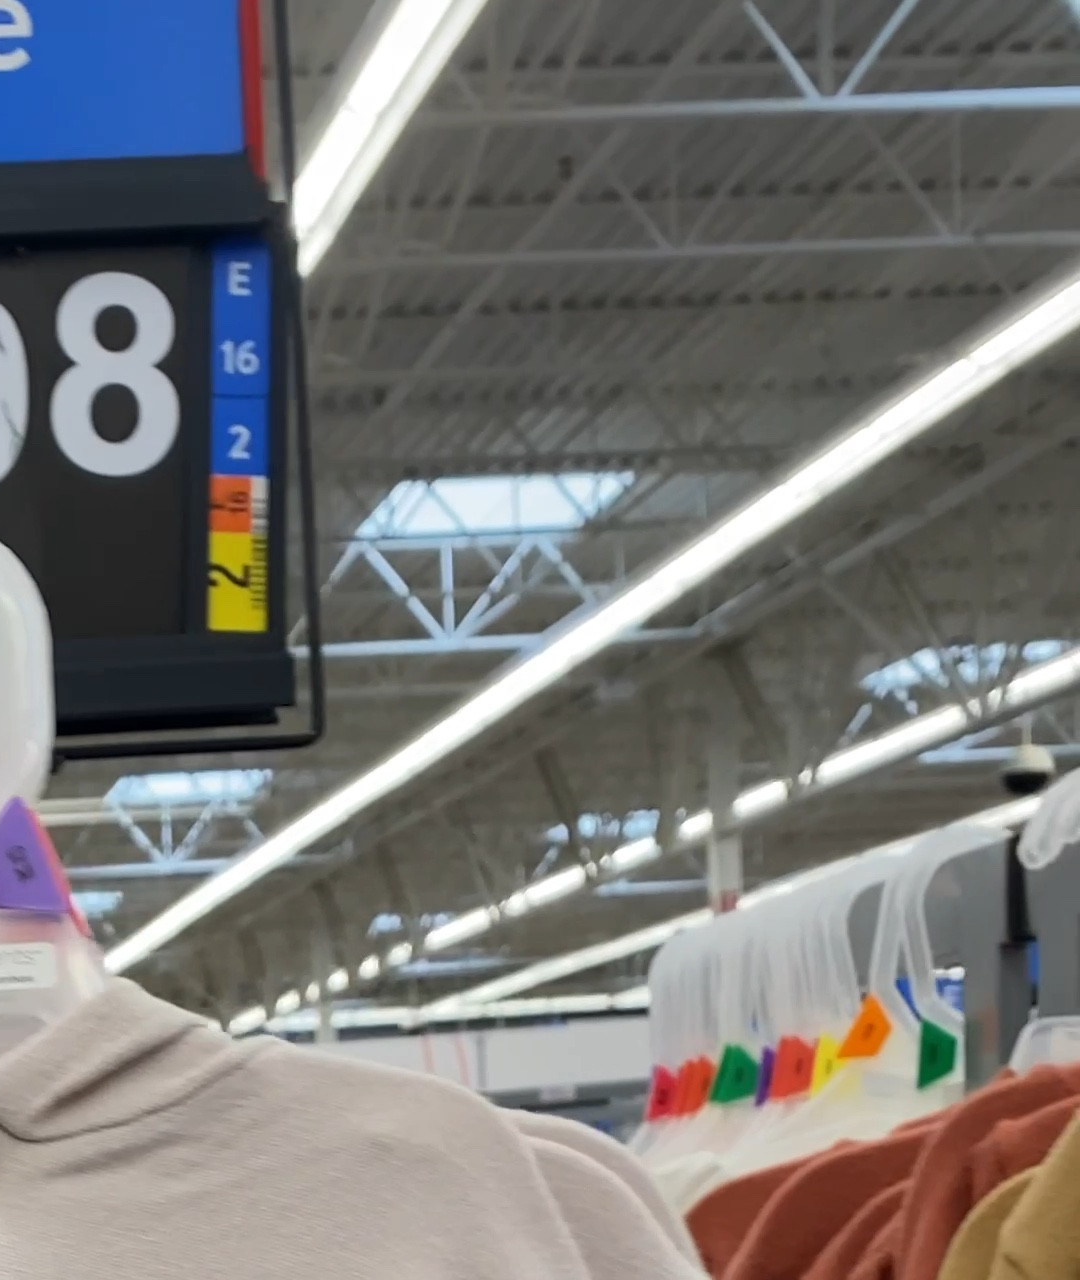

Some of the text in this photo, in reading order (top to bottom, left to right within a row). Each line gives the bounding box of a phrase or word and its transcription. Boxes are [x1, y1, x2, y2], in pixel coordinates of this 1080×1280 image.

[227, 261, 252, 296] E
[220, 339, 261, 375] 16
[227, 424, 252, 460] 2
